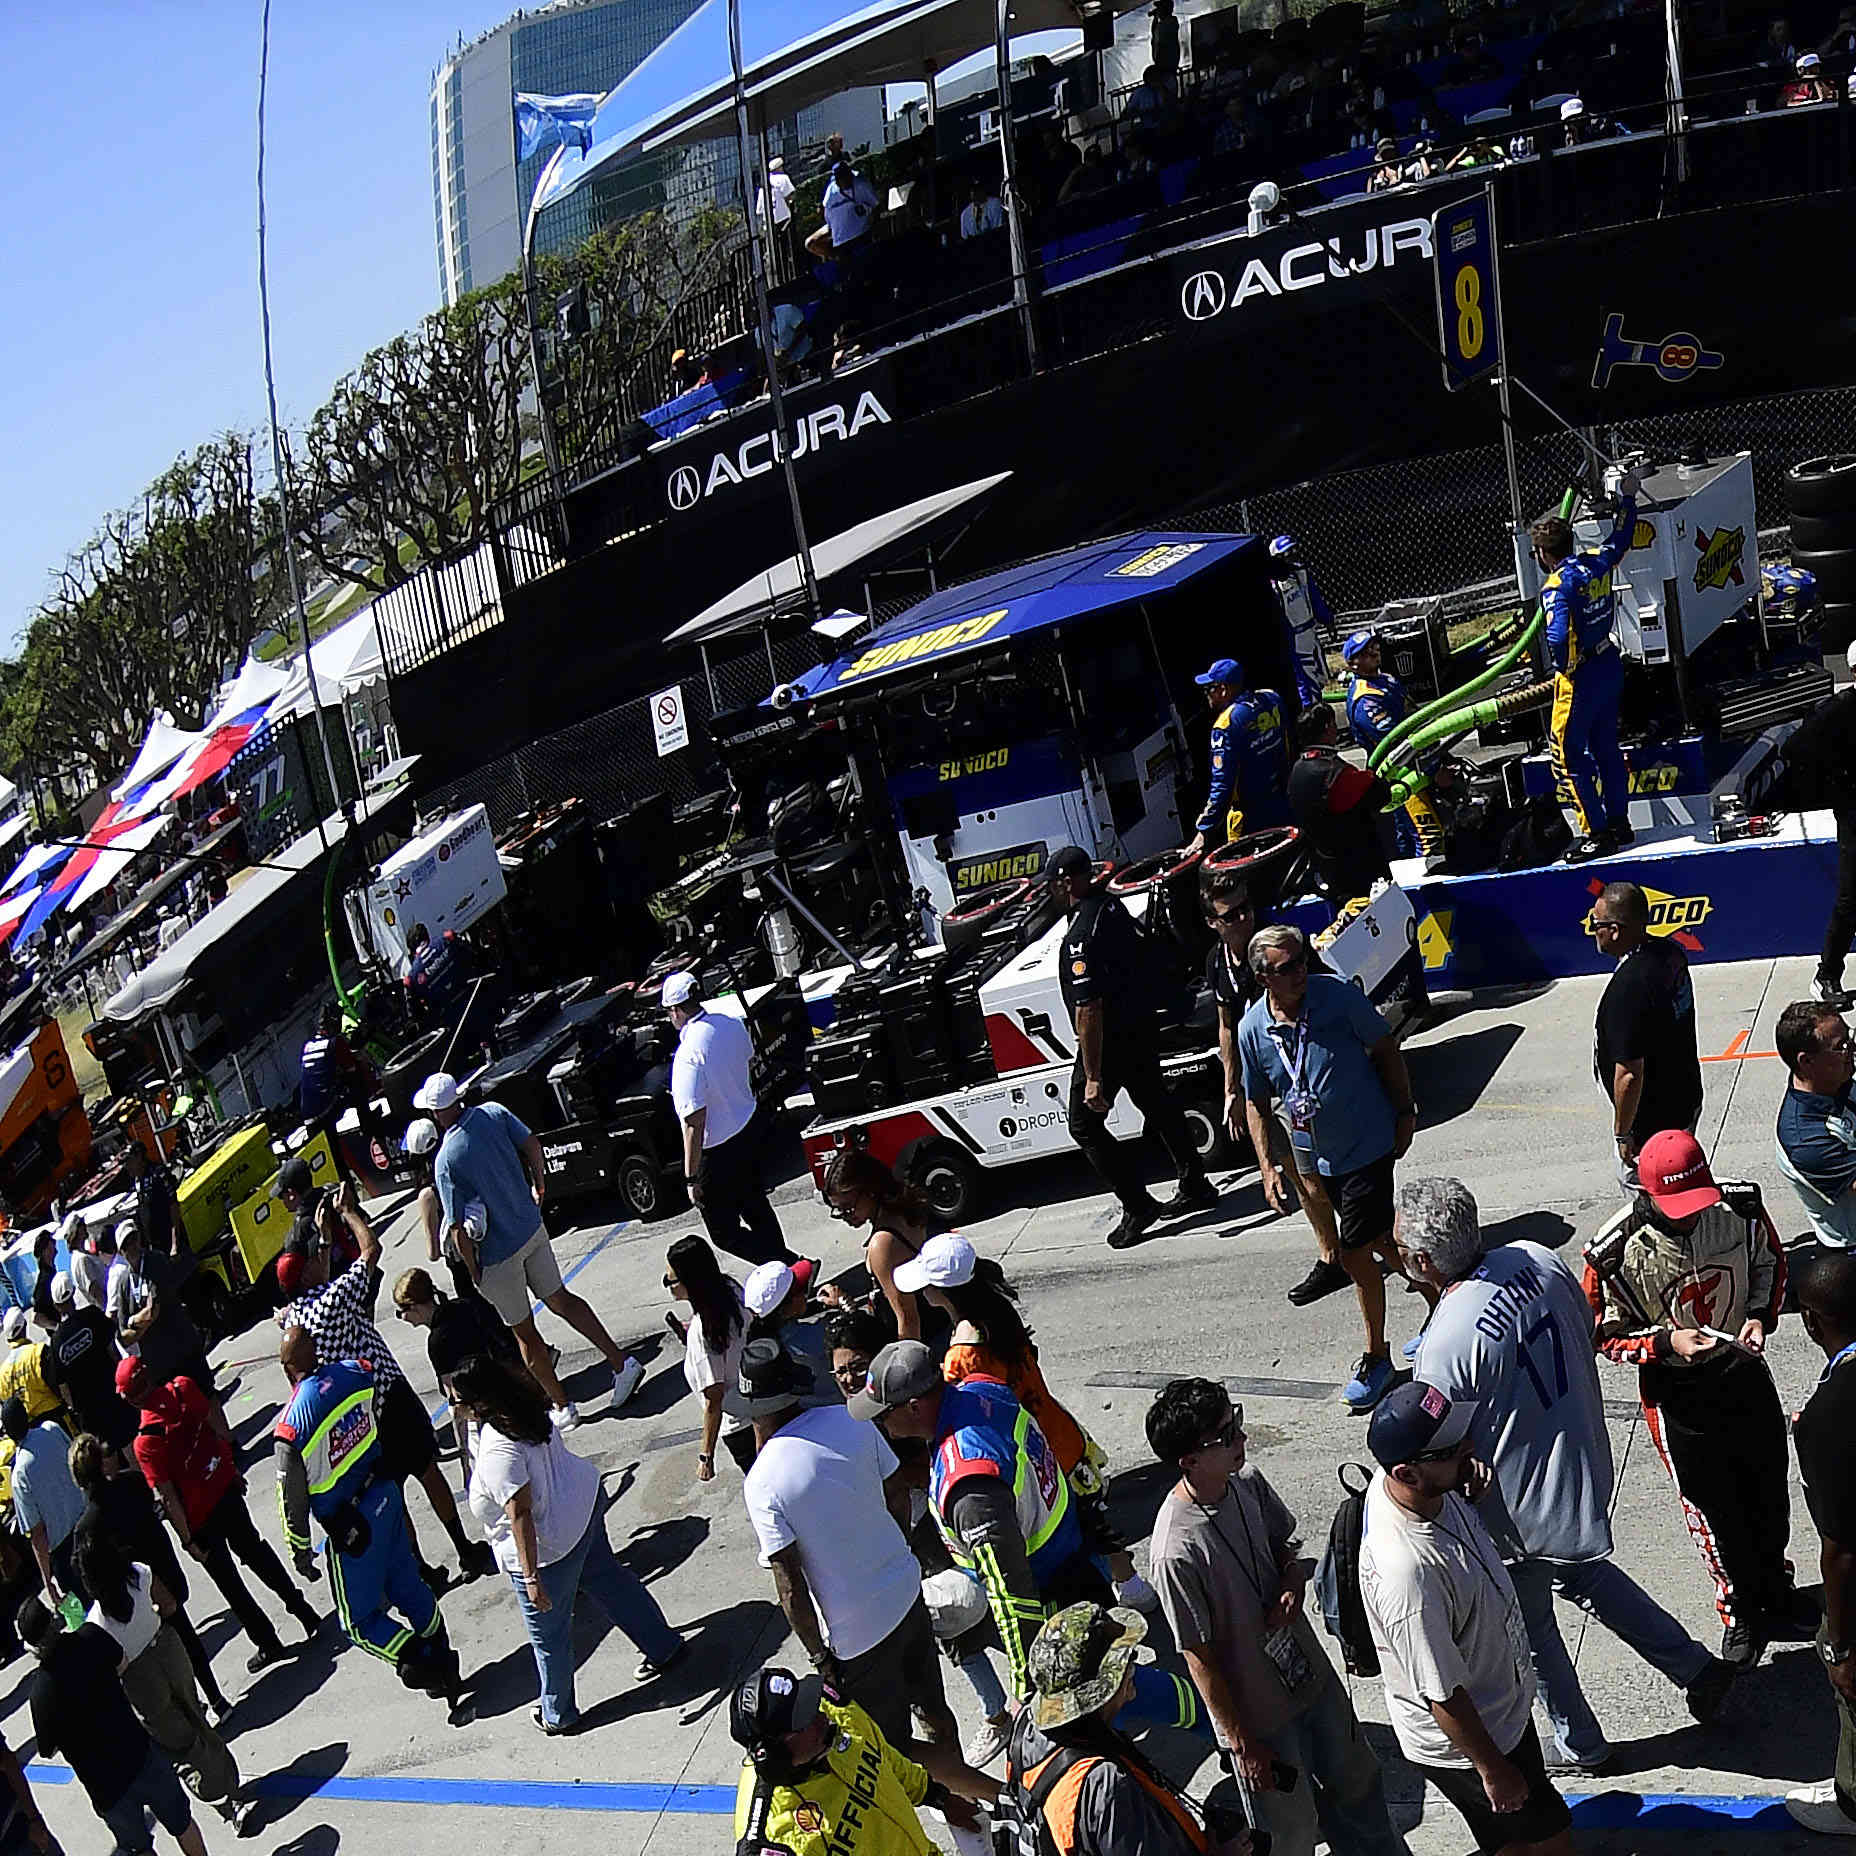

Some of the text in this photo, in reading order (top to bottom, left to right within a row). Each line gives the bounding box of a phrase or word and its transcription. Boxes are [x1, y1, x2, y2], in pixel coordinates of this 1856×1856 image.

[1231, 218, 1434, 308] ACUR
[1455, 264, 1482, 360] 8
[704, 390, 891, 497] ACURA
[1697, 531, 1745, 589] SUNOCO
[837, 609, 1009, 681] SUNOCO
[939, 747, 1009, 782] SUNOCO
[957, 852, 1040, 889] SUNOCO
[1649, 896, 1708, 926] OCO
[542, 1141, 583, 1159] Delaware
[1018, 1110, 1069, 1132] DROPL
[1474, 1266, 1546, 1343] OHTANI
[1516, 1310, 1570, 1411] 17
